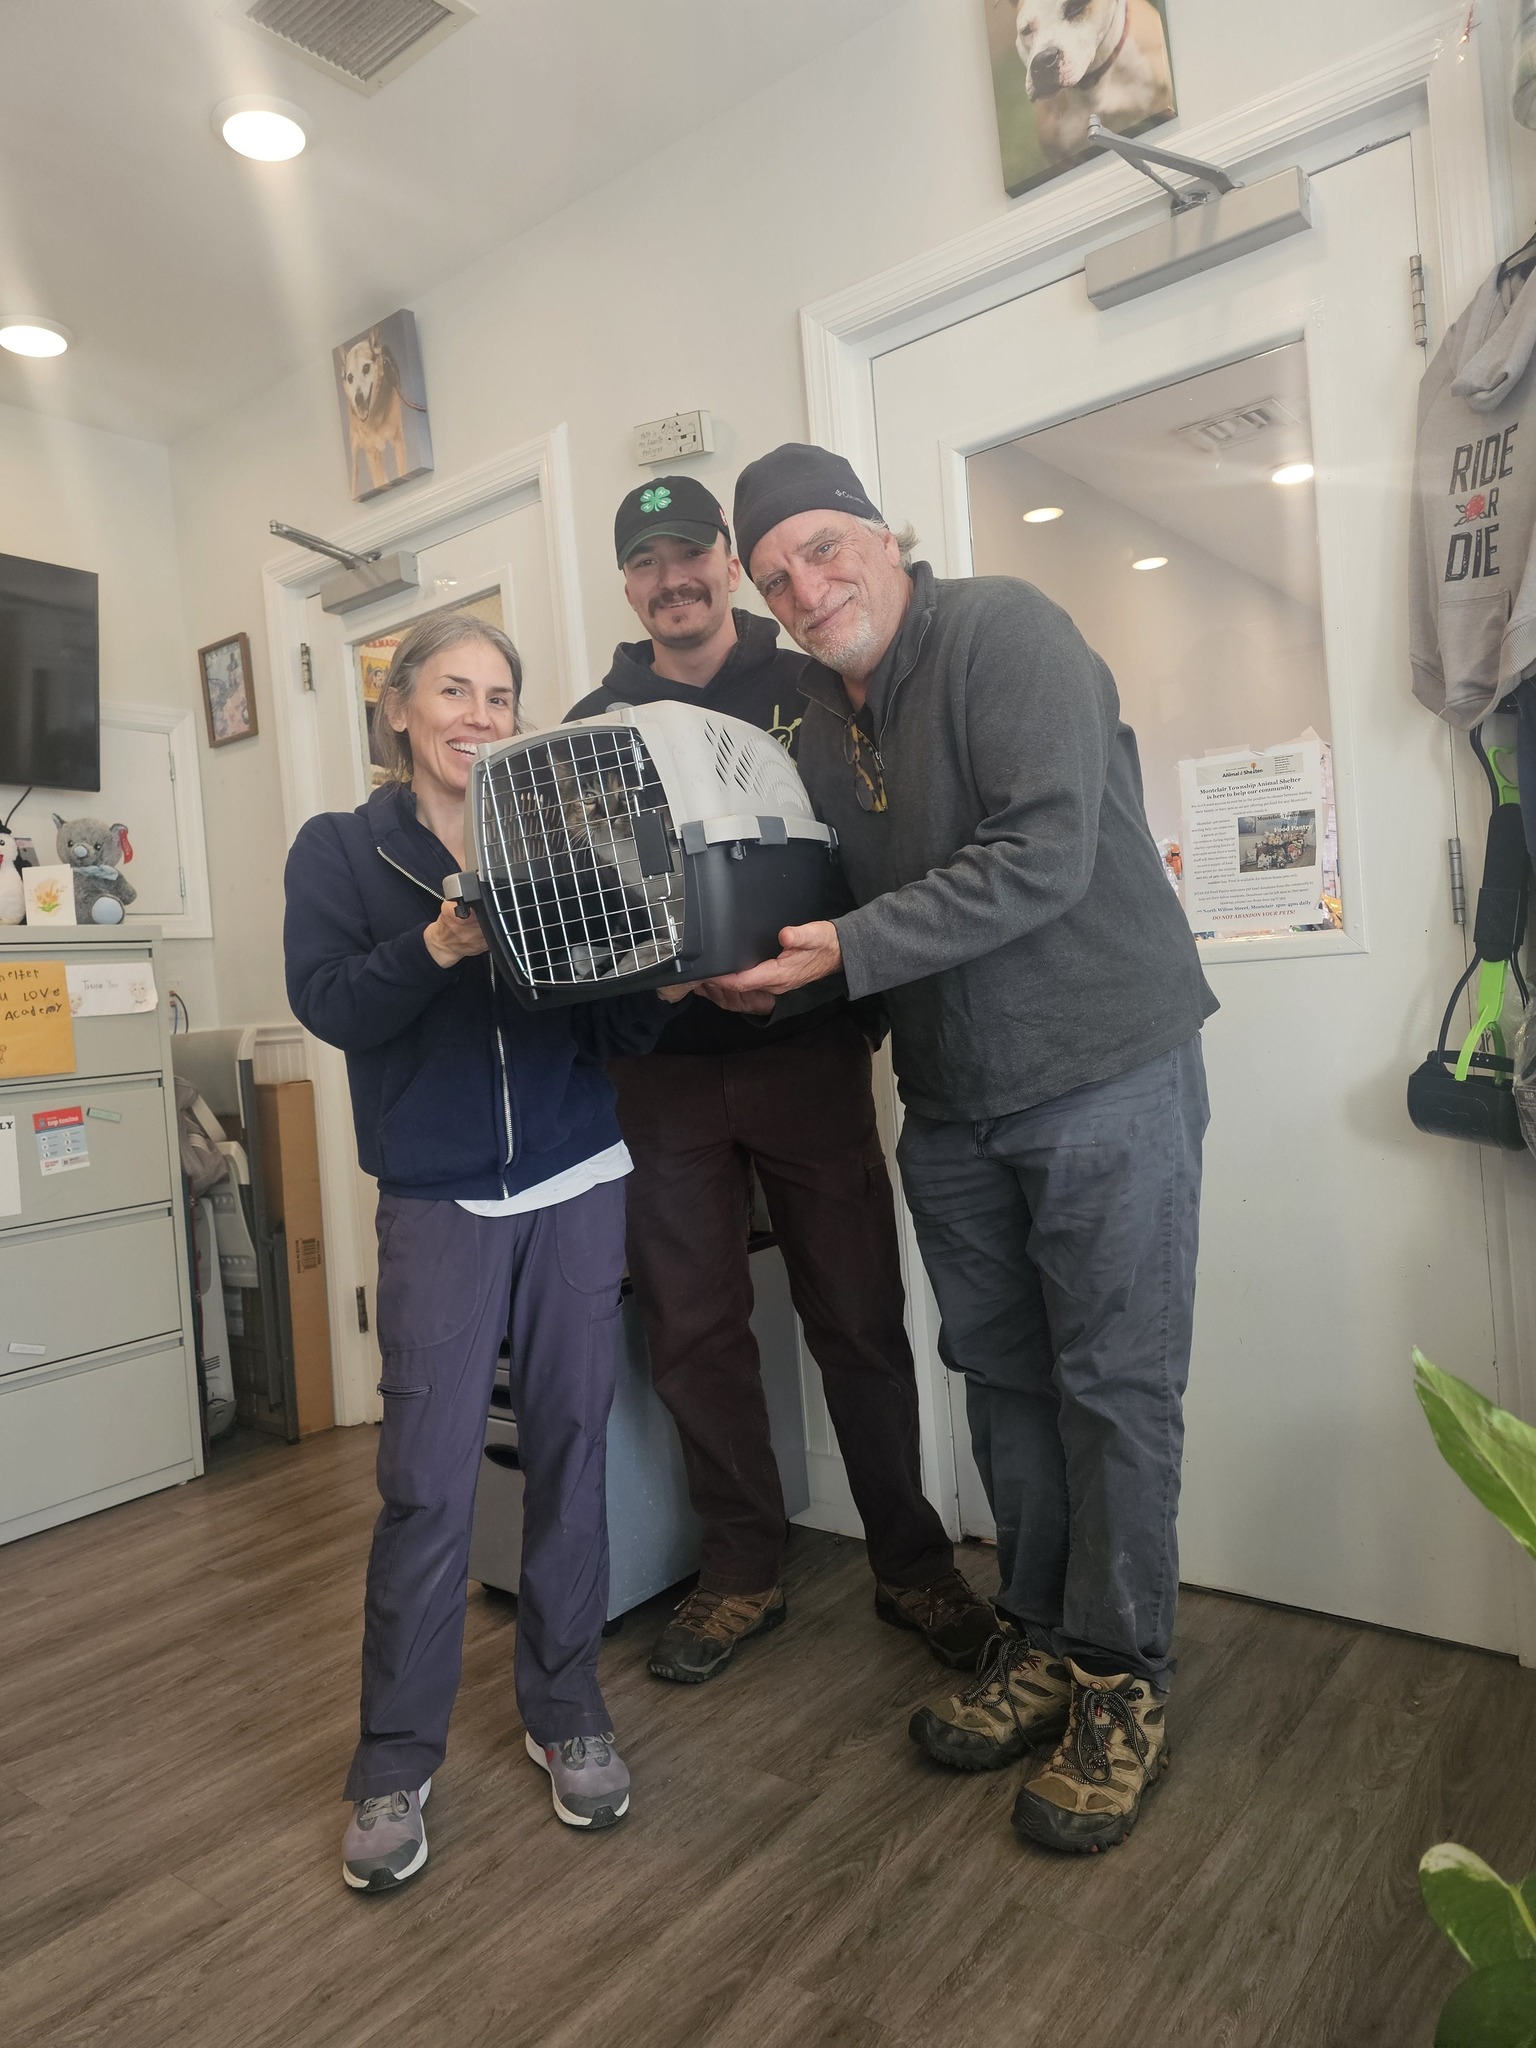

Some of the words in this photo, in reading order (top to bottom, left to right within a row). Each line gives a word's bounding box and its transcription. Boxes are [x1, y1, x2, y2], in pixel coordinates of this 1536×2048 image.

[1448, 422, 1519, 496] RIDE
[1444, 523, 1500, 582] DIE
[1228, 783, 1256, 791] Township
[1258, 785, 1294, 793] community.
[1291, 824, 1312, 832] Pantry
[47, 1119, 59, 1127] top
